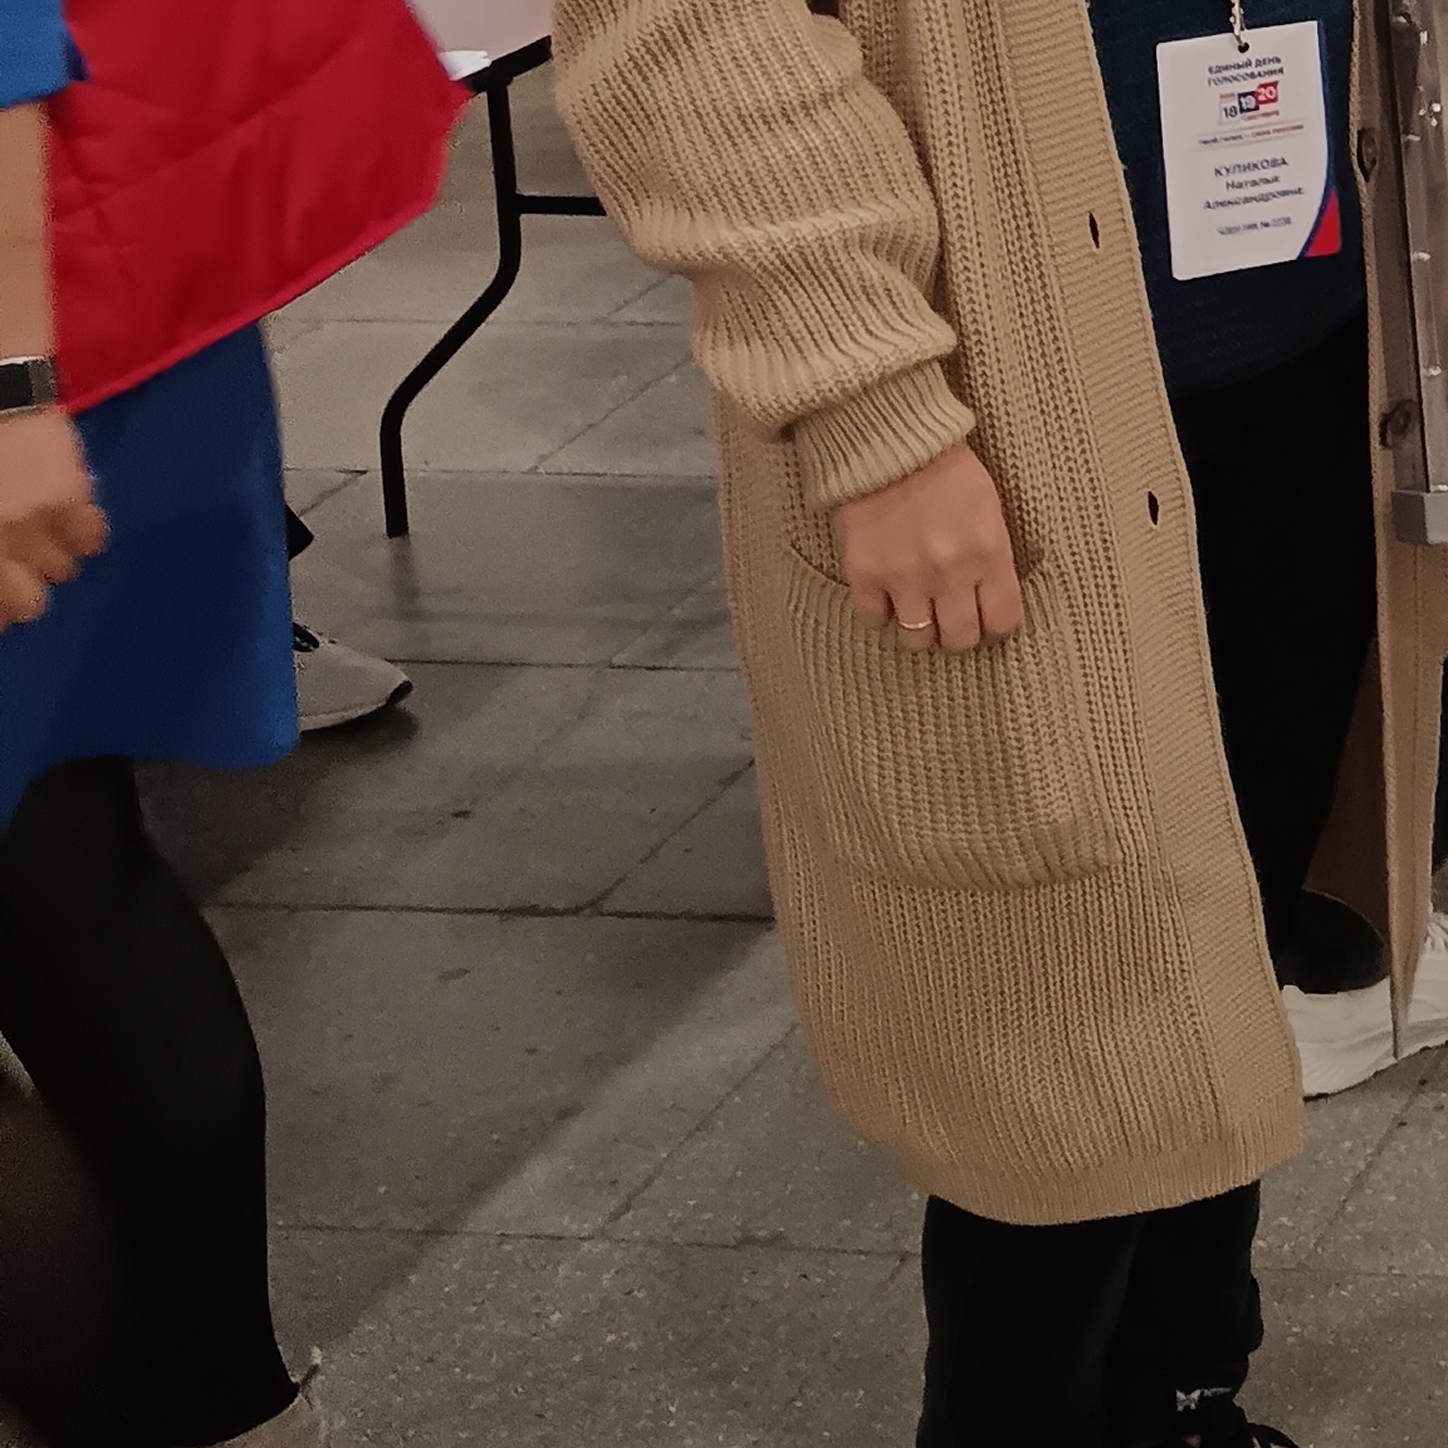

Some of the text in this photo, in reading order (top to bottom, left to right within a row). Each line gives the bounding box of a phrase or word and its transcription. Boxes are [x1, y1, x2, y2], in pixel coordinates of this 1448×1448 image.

[1208, 56, 1282, 75] ЕДИНЫЙ ДЕНЬ
[1223, 105, 1238, 119] 18
[1257, 85, 1277, 102] 20
